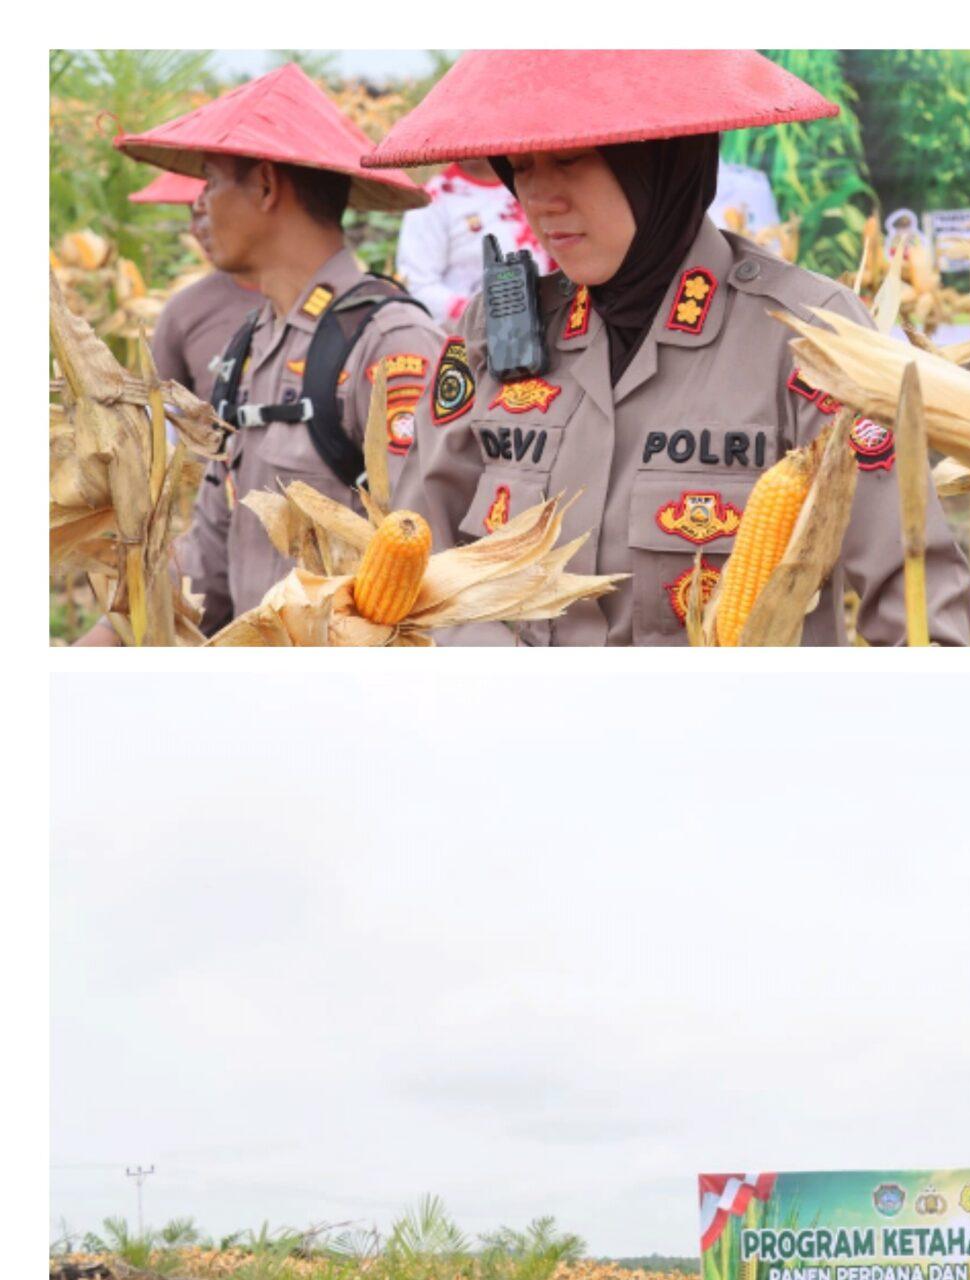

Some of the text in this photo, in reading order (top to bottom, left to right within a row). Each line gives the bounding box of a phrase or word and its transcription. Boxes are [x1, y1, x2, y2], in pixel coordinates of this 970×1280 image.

[479, 427, 547, 464] DEVI
[642, 429, 766, 468] POLRI
[742, 1228, 876, 1260] PROGRAM
